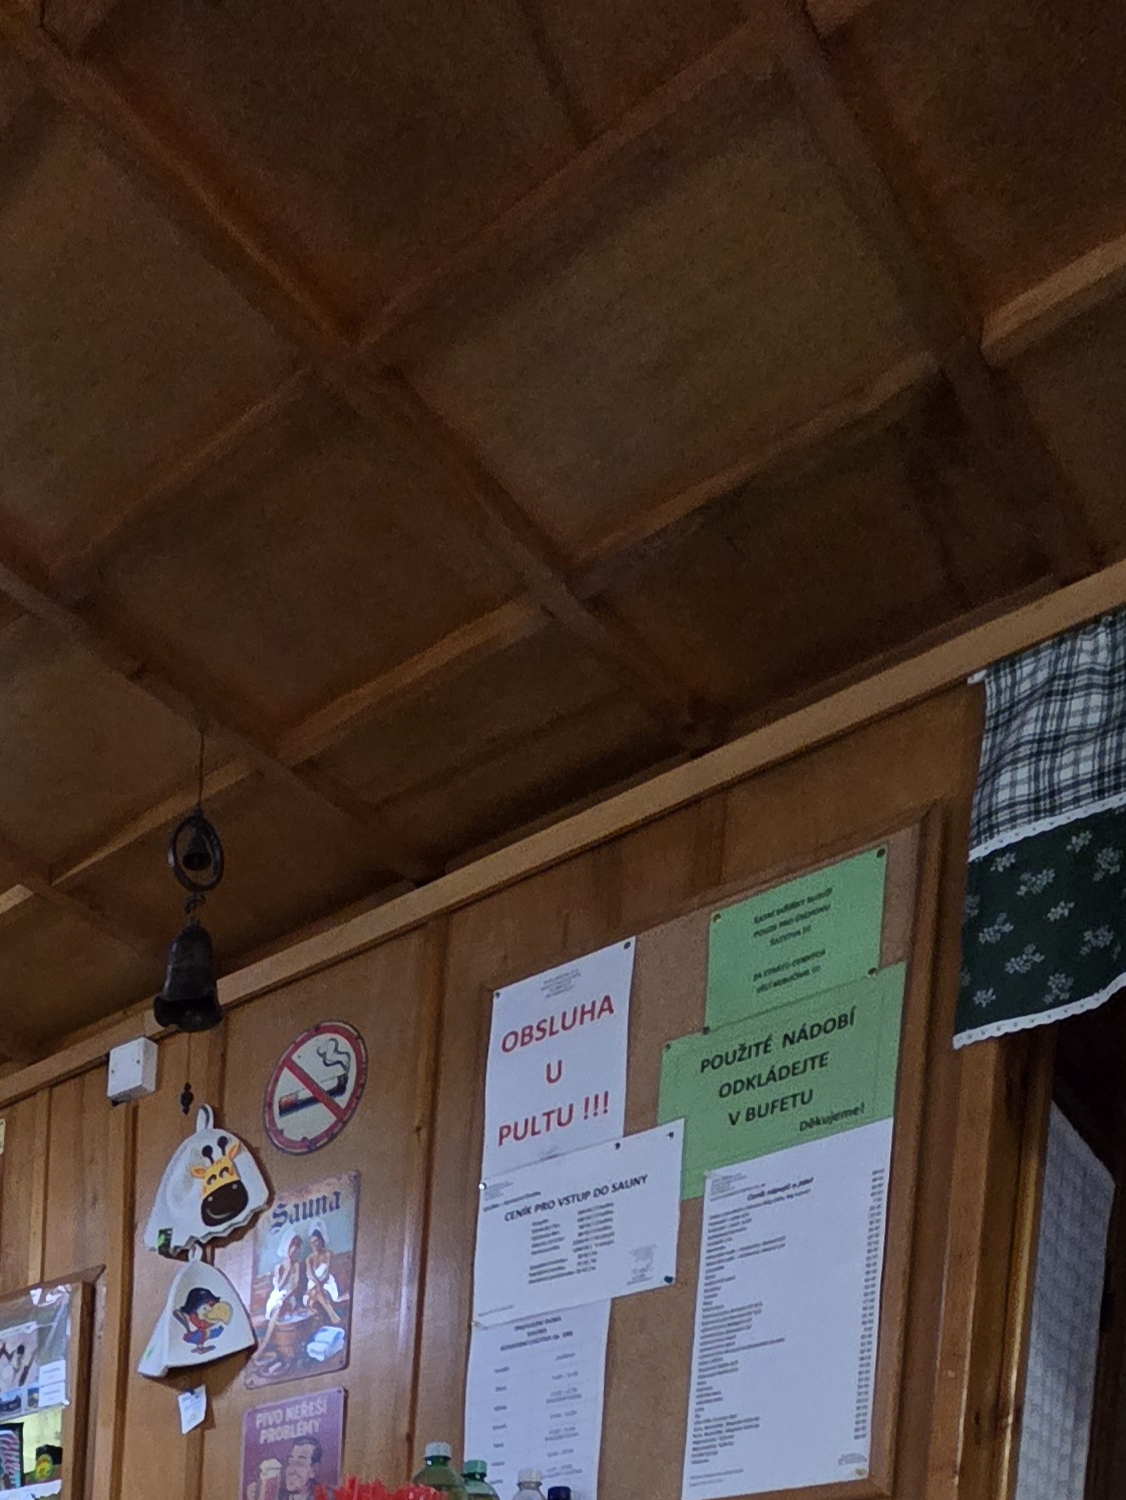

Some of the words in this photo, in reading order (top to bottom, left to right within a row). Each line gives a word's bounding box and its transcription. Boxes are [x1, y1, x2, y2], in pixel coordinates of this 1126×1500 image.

[501, 994, 615, 1053] OBSLUHA
[700, 1034, 773, 1073] POUŽITÉ
[782, 1005, 857, 1048] NÁDOBÍ
[545, 1059, 563, 1084] U
[718, 1051, 830, 1099] ODKLÁDEJTE
[498, 1103, 574, 1147] PULTU
[728, 1111, 741, 1126] V
[745, 1089, 814, 1122] BUFETU
[271, 1191, 341, 1234] Sauna
[504, 1205, 532, 1222] CENÍK
[534, 1201, 555, 1214] PRO
[558, 1190, 591, 1207] VSTUP
[593, 1185, 609, 1199] DO
[611, 1174, 648, 1193] SAUNY
[256, 1408, 283, 1429] PIVO
[286, 1395, 328, 1422] NEŘEŠÍ
[259, 1418, 322, 1444] PROBLÉMY
